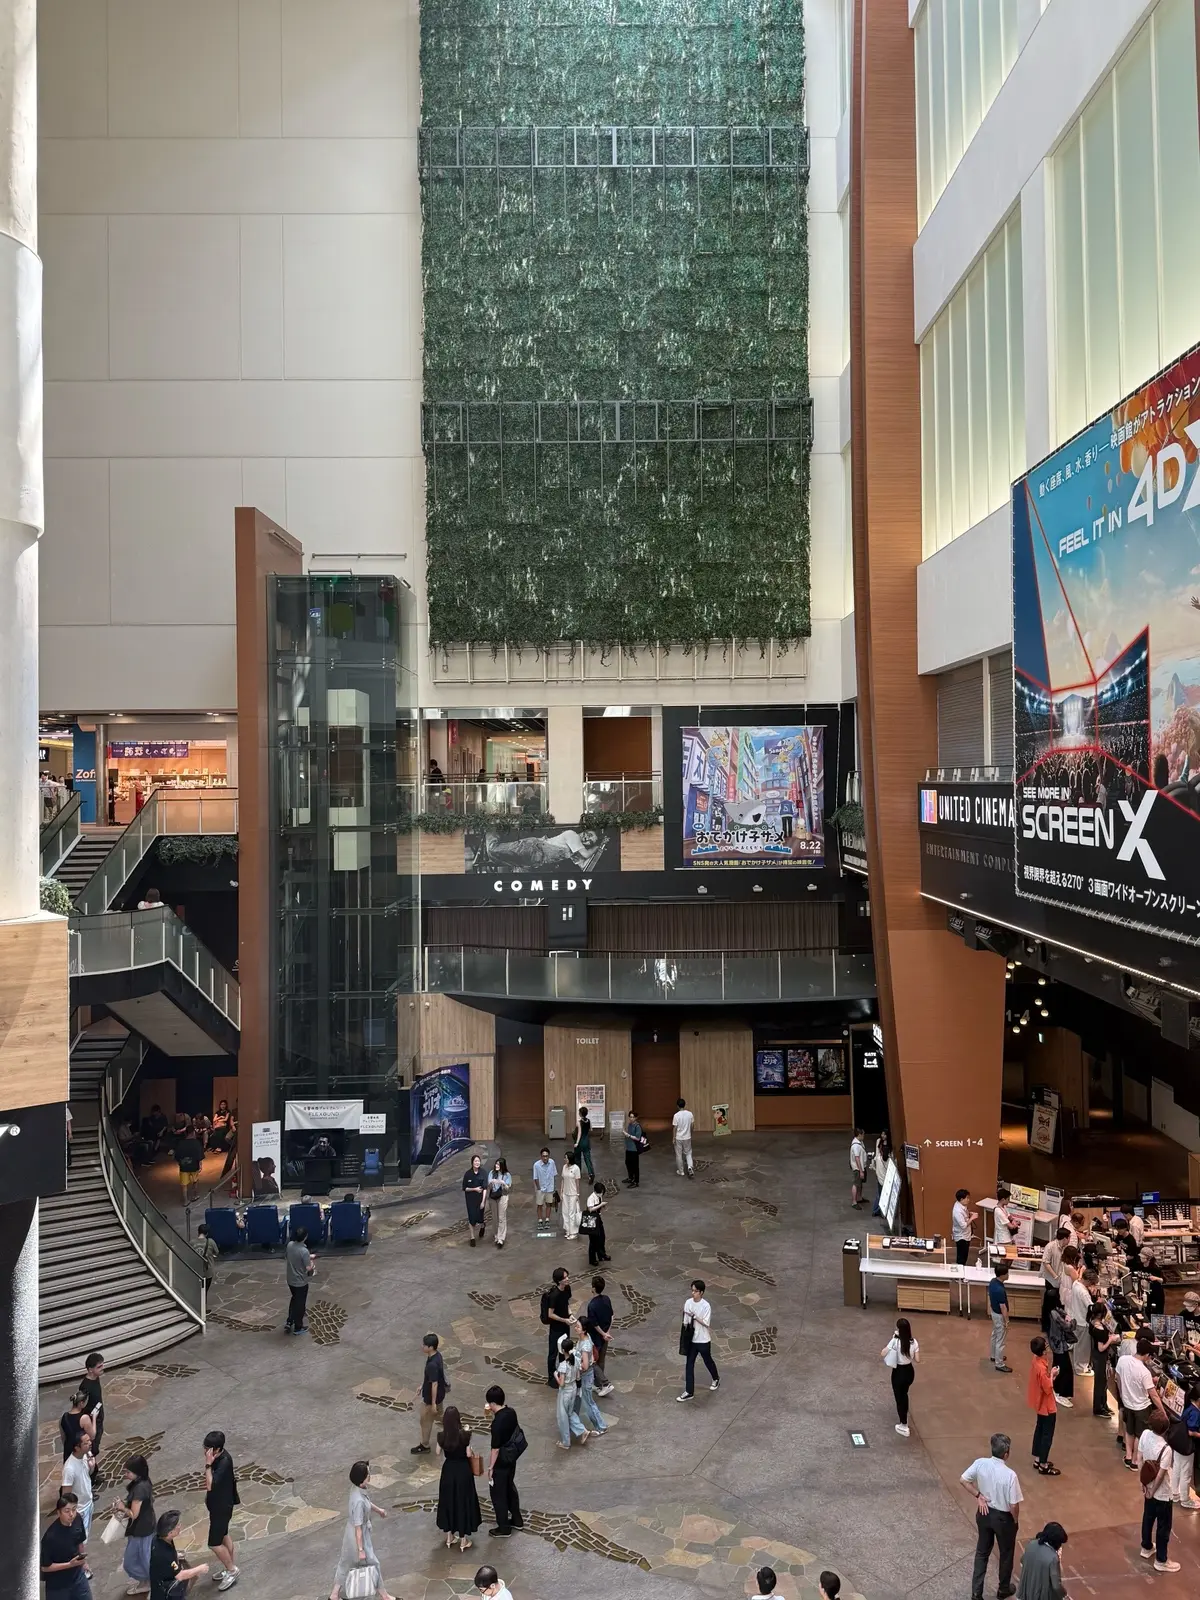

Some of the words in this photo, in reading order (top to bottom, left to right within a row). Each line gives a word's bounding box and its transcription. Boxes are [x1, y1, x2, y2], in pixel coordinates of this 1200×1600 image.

[1059, 528, 1089, 558] FEEL
[1092, 516, 1105, 541] IT
[1108, 507, 1122, 533] IN
[1023, 787, 1036, 799] SEE
[1037, 787, 1060, 800] MORE
[1062, 787, 1070, 800] IN
[938, 795, 971, 823] UNITED
[696, 830, 784, 844] おでかけ子ザメ
[800, 841, 821, 850] 8.22
[926, 842, 980, 866] ENTERTAINMENT
[493, 879, 592, 892] COMEDY
[1006, 1009, 1030, 1022] 1-4
[576, 1037, 599, 1045] TOILET
[966, 1138, 983, 1147] 1-4
